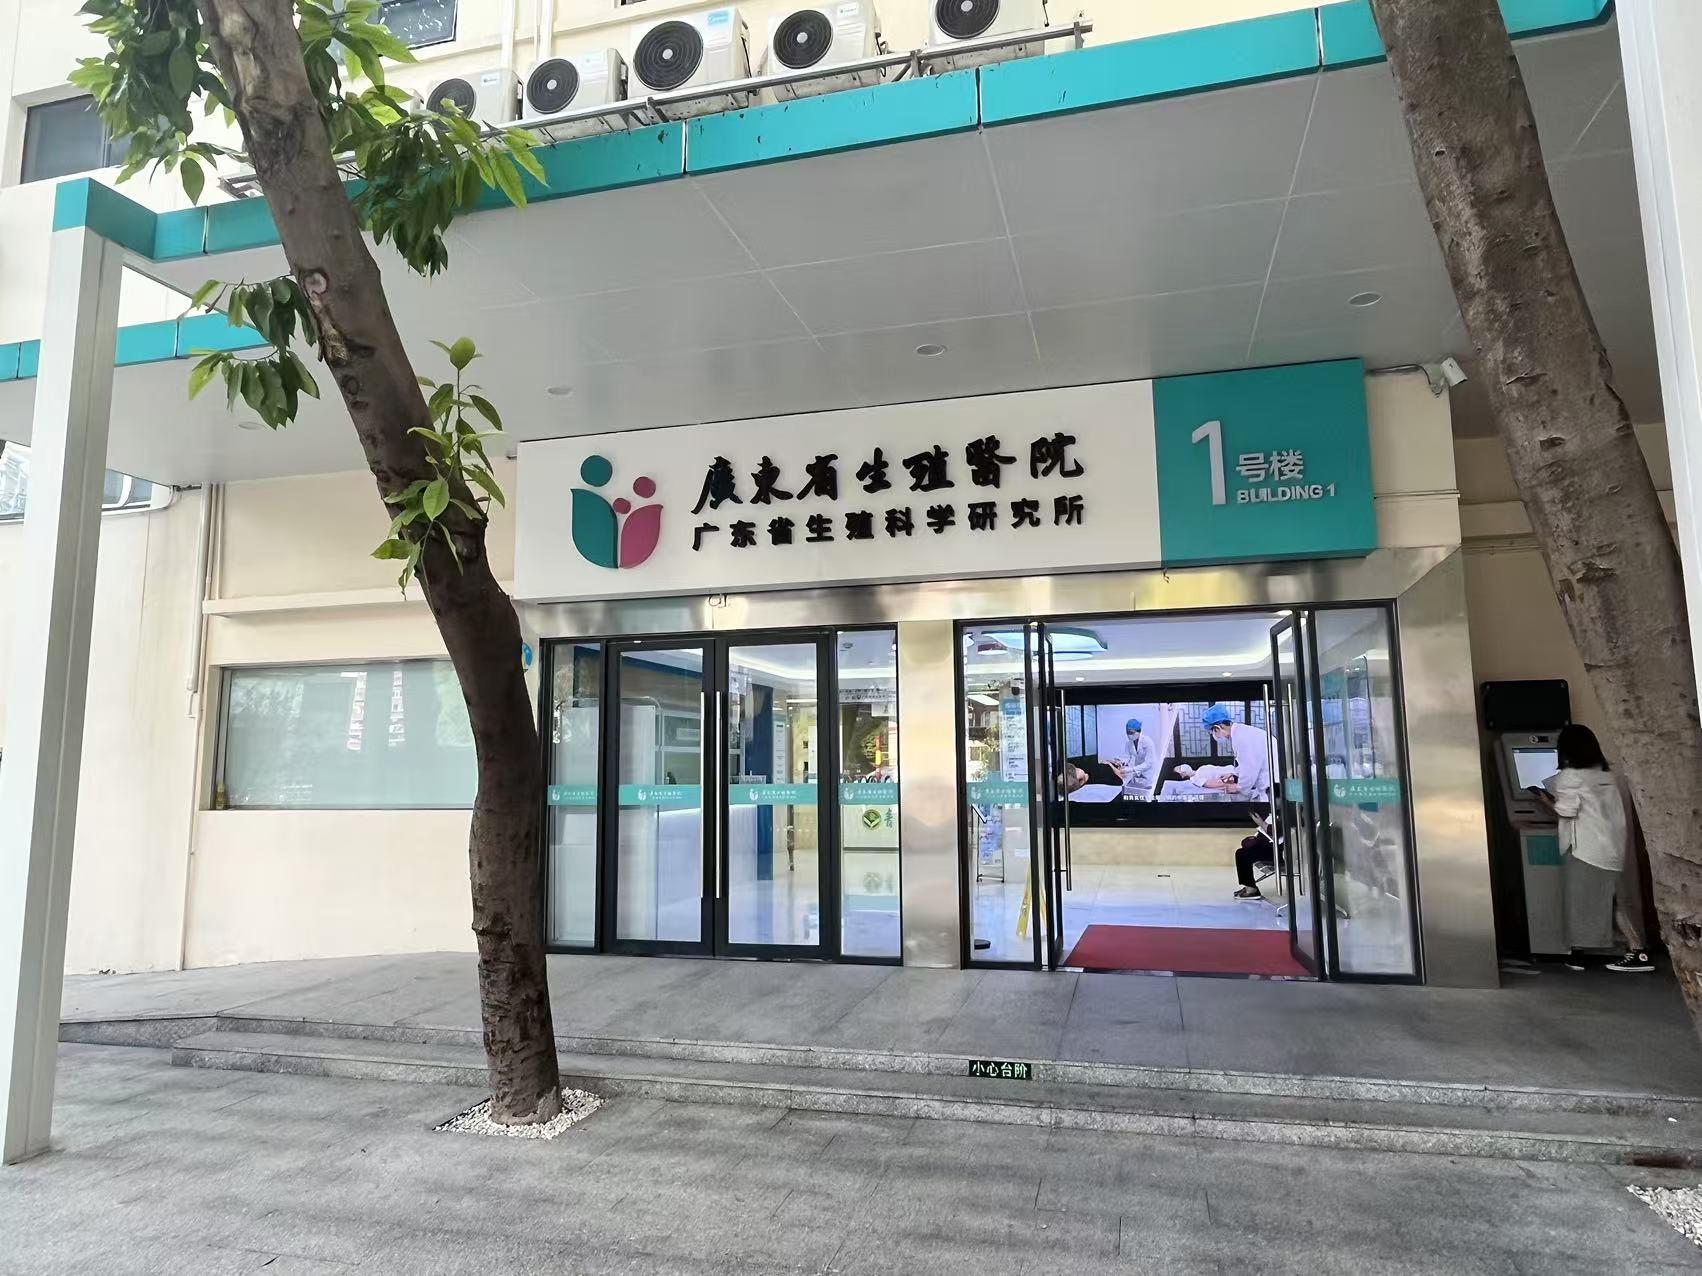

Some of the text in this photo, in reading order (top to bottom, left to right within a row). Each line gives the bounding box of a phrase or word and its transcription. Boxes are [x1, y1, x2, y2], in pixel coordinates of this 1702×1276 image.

[1236, 482, 1336, 504] BUILDING 1
[691, 494, 1084, 551] 广东省生殖科学研究所
[972, 1060, 1028, 1079] 小心台阶
